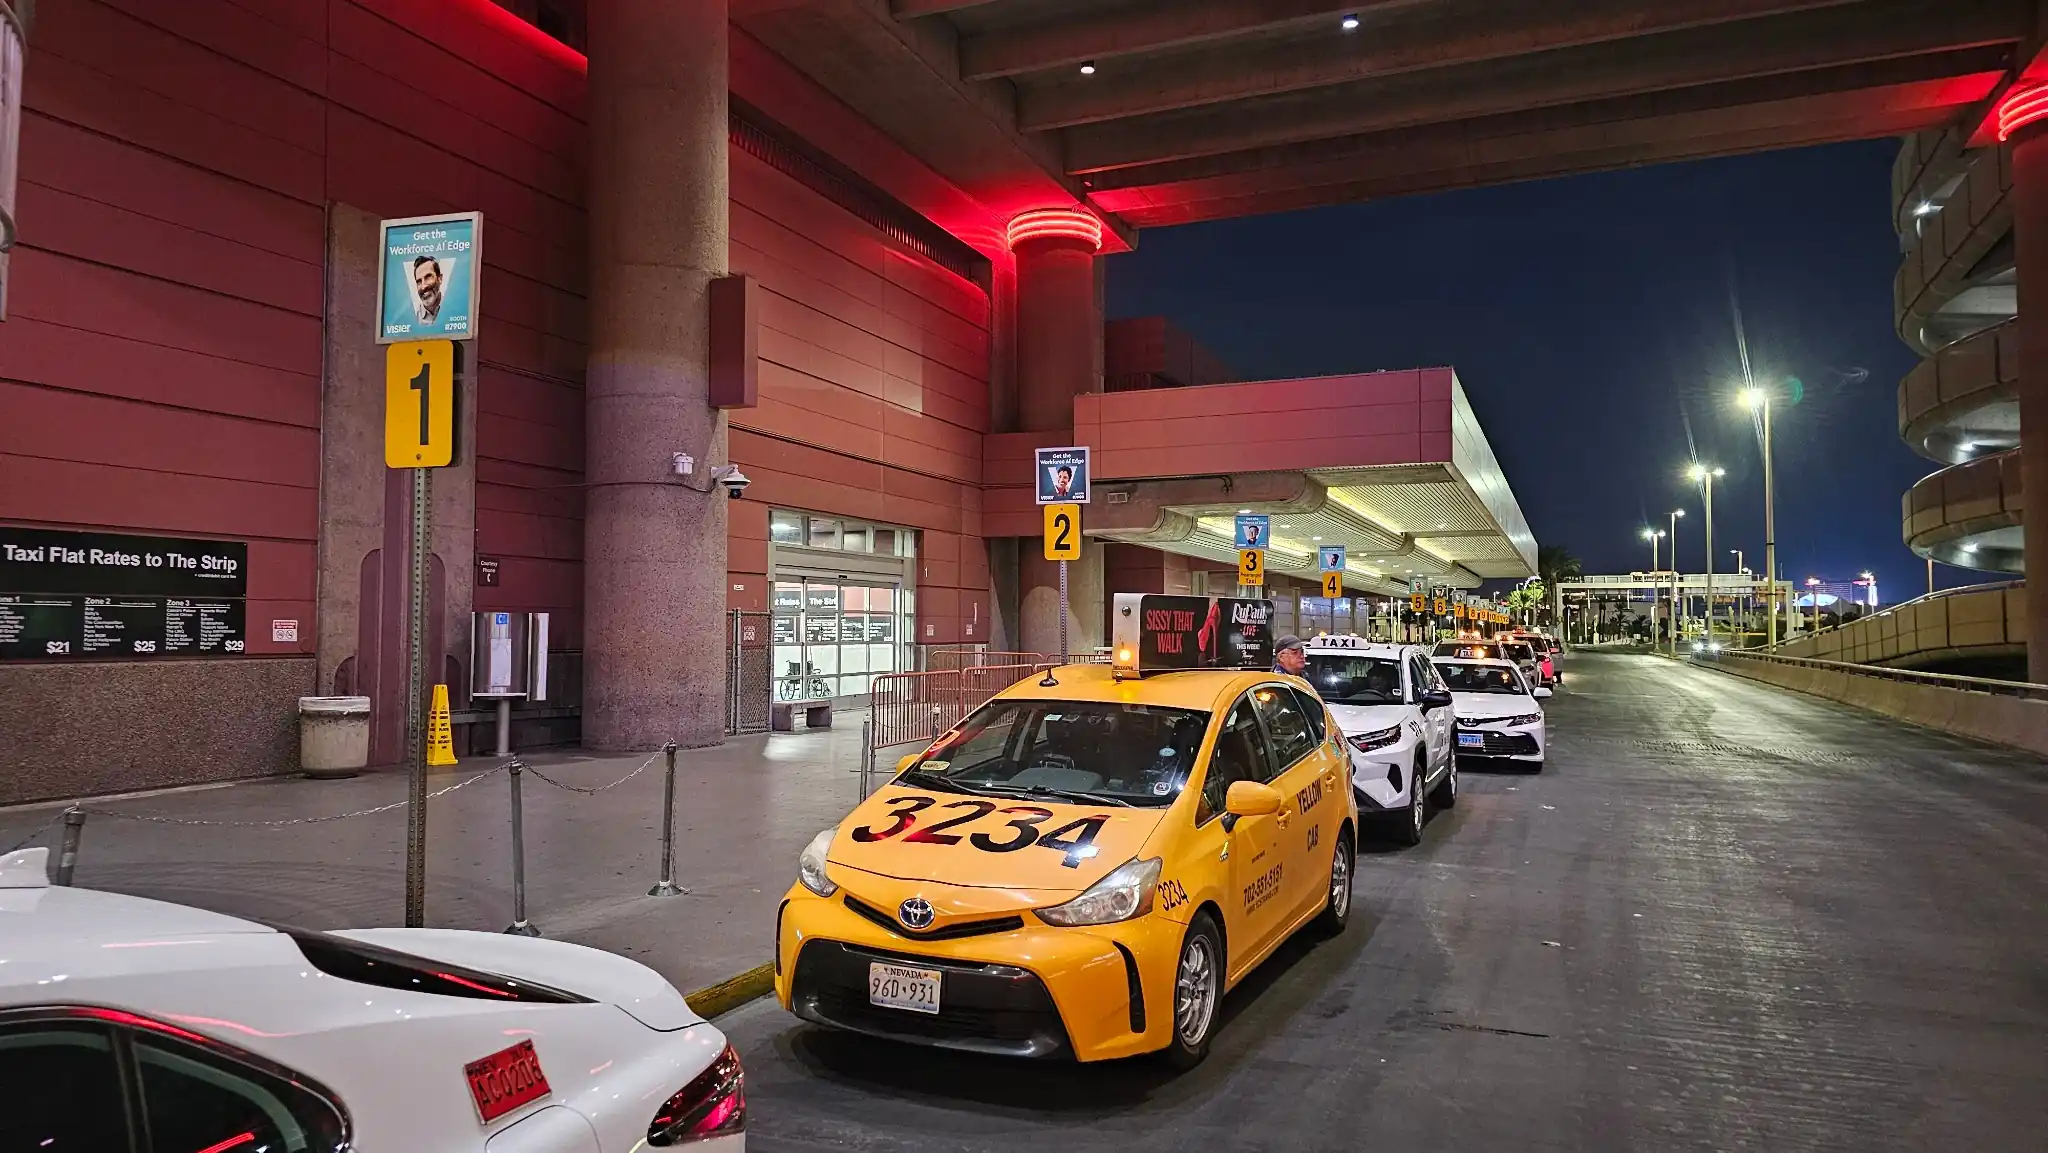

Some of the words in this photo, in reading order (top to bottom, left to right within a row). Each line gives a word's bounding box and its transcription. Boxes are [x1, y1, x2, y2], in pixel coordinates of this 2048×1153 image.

[413, 232, 429, 240] Get
[432, 228, 447, 239] the
[389, 243, 435, 255] Workforce
[447, 240, 470, 251] Edge
[410, 363, 430, 446] 1
[1054, 514, 1071, 550] 2
[3, 544, 44, 562] Taxi
[50, 546, 85, 564] Flat
[90, 548, 141, 567] Rates
[145, 553, 163, 568] to
[167, 553, 197, 569] The
[201, 555, 238, 573] Strip
[1245, 551, 1257, 571] 3
[1328, 576, 1336, 594] 4
[84, 597, 105, 605] Zone
[105, 597, 111, 605] 2
[1415, 597, 1421, 608] 5
[1437, 602, 1443, 612] 6
[1457, 606, 1462, 615] 7
[1470, 609, 1475, 618] 8
[1481, 611, 1486, 619] 9
[1146, 609, 1173, 631] SISSY
[1174, 610, 1195, 631] THAT
[1242, 625, 1257, 637] LIVE
[46, 641, 70, 654] $21
[134, 640, 156, 652] $25
[224, 640, 245, 652] $29
[1157, 633, 1183, 654] WALK
[1320, 638, 1356, 647] TAXI
[1296, 779, 1323, 815] YELLOW
[851, 796, 1112, 869] 3234
[1307, 824, 1319, 852] CAB
[1243, 861, 1283, 907] 702-551-5151
[1157, 878, 1190, 911] 3234
[890, 967, 922, 980] NEVADA
